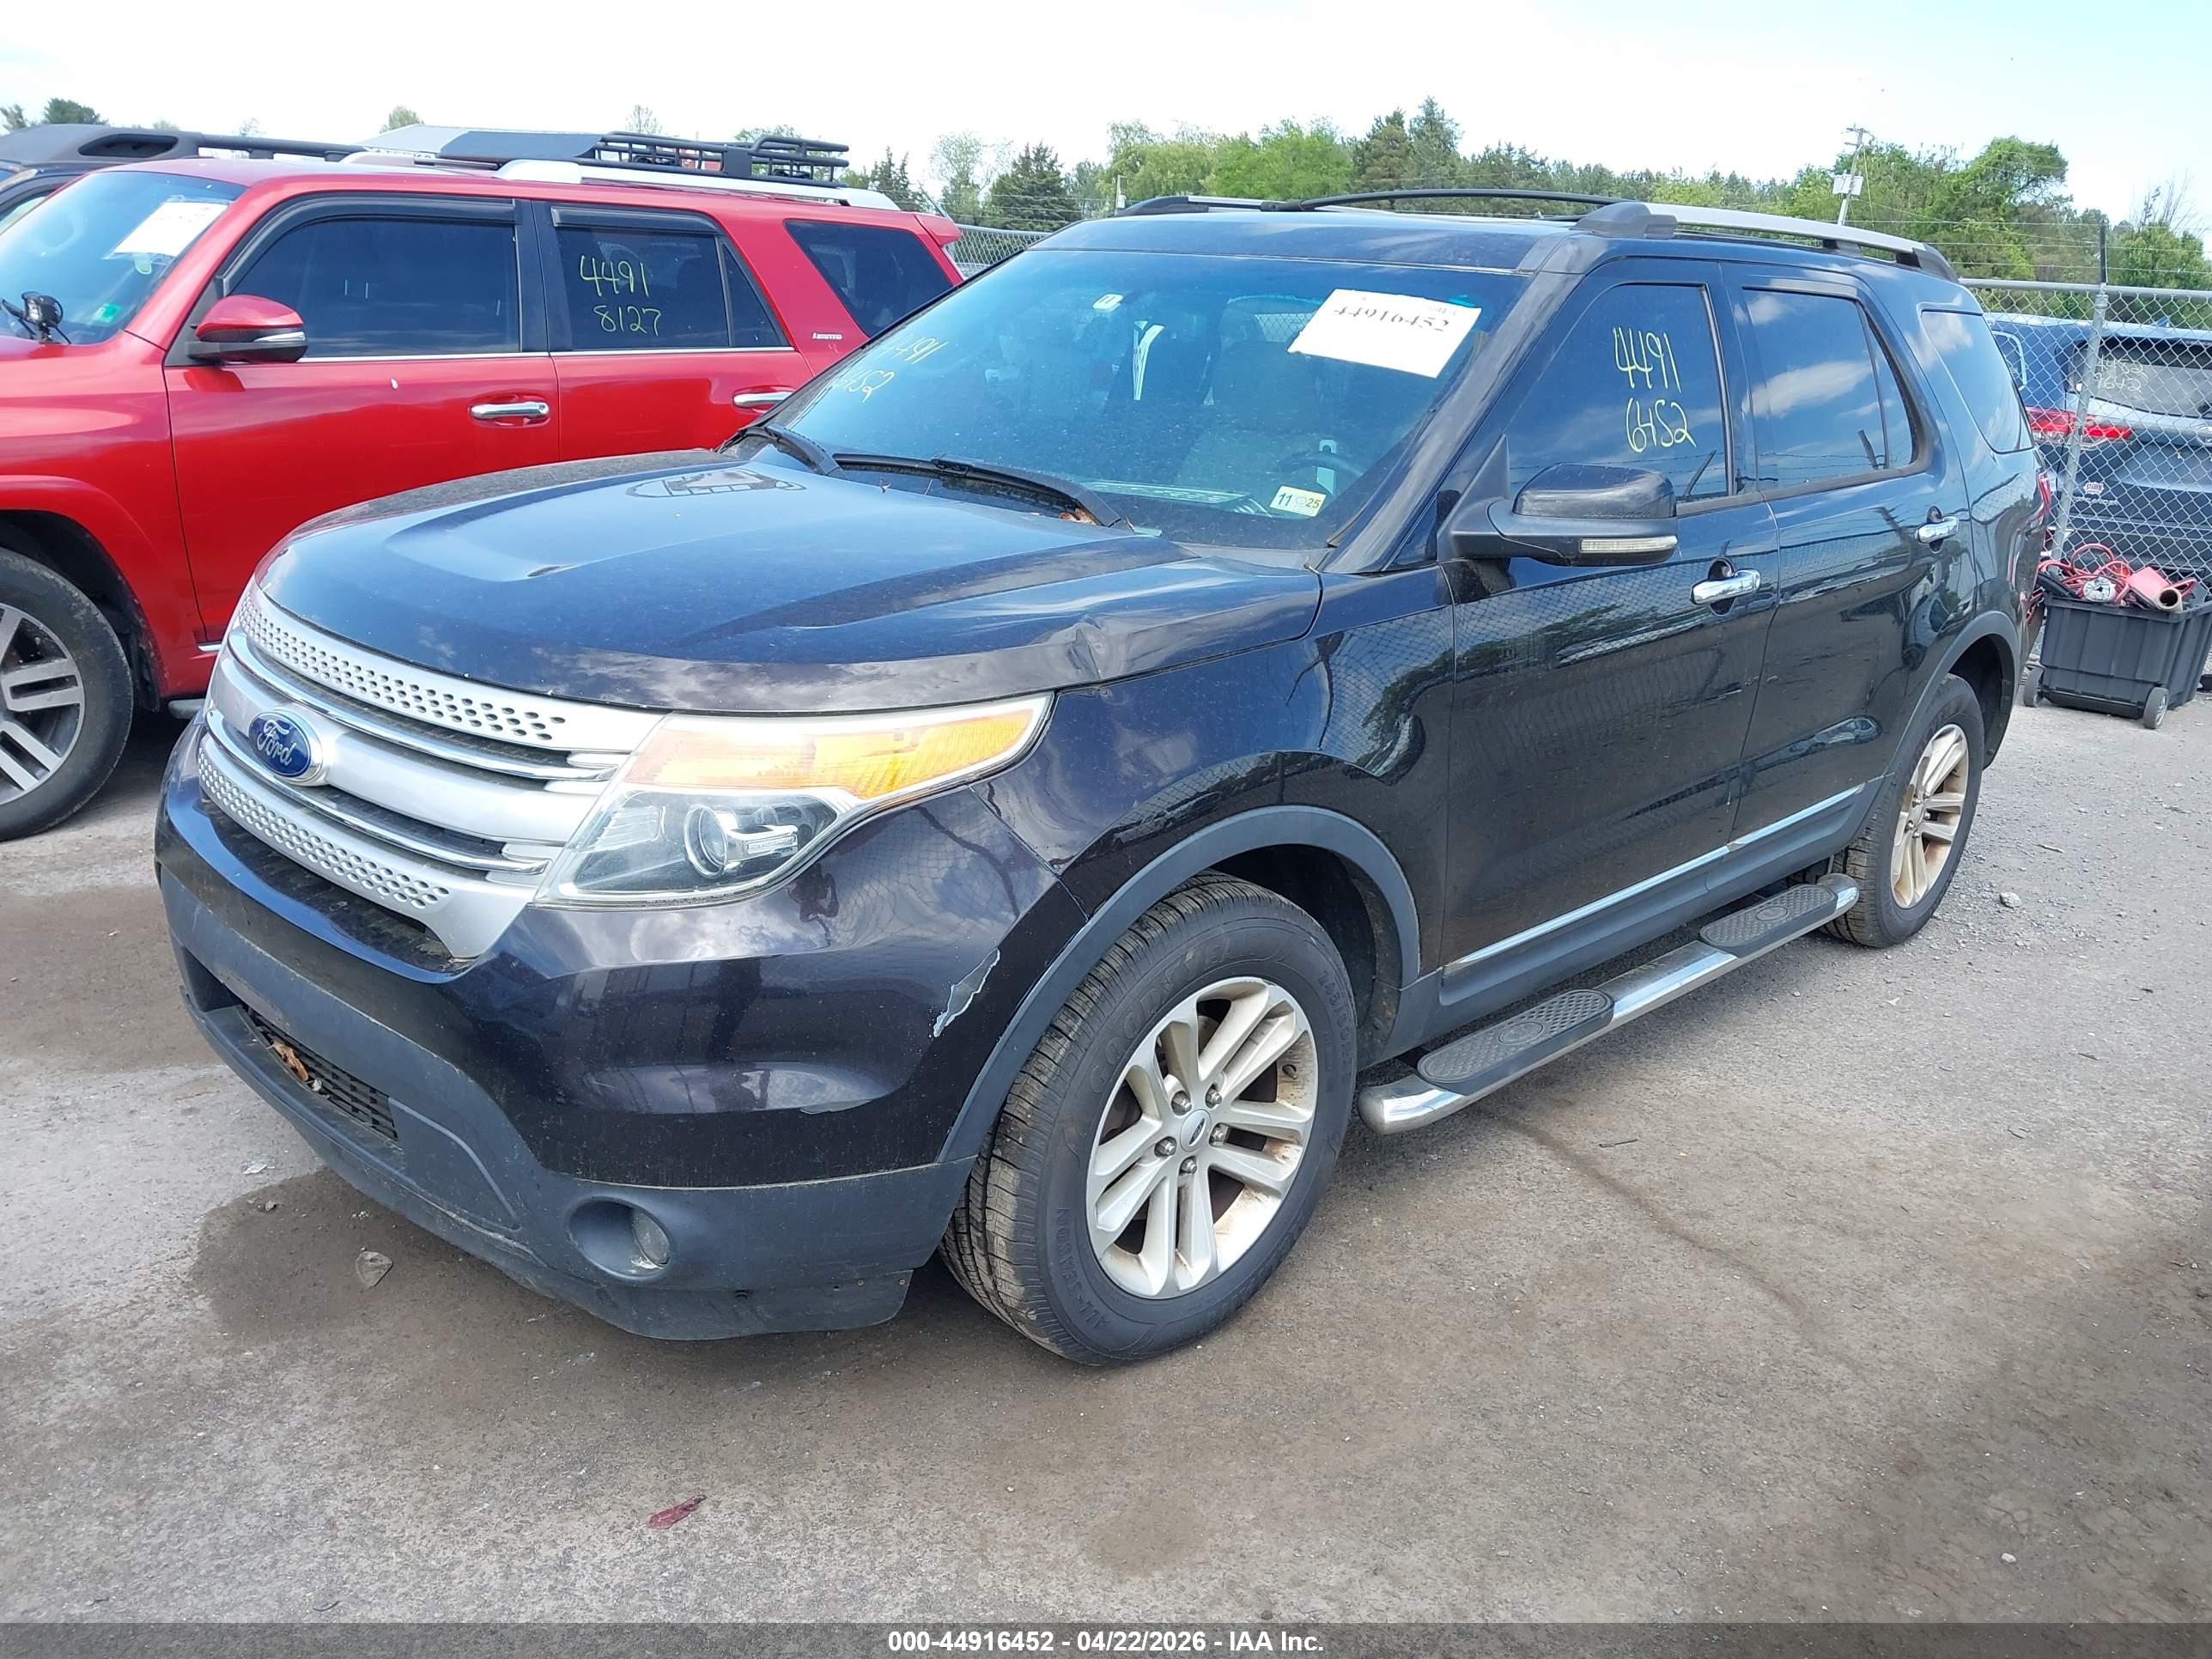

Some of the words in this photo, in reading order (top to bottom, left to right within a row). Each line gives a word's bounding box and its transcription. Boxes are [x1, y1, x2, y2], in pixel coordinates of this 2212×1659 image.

[580, 255, 649, 298] 4491
[592, 305, 661, 337] 8127
[1334, 306, 1450, 332] 44916452
[1613, 326, 1682, 393] 4491
[1626, 397, 1697, 453] 6452
[1278, 493, 1293, 507] 11
[1305, 497, 1322, 509] 25
[257, 719, 297, 766] Ford
